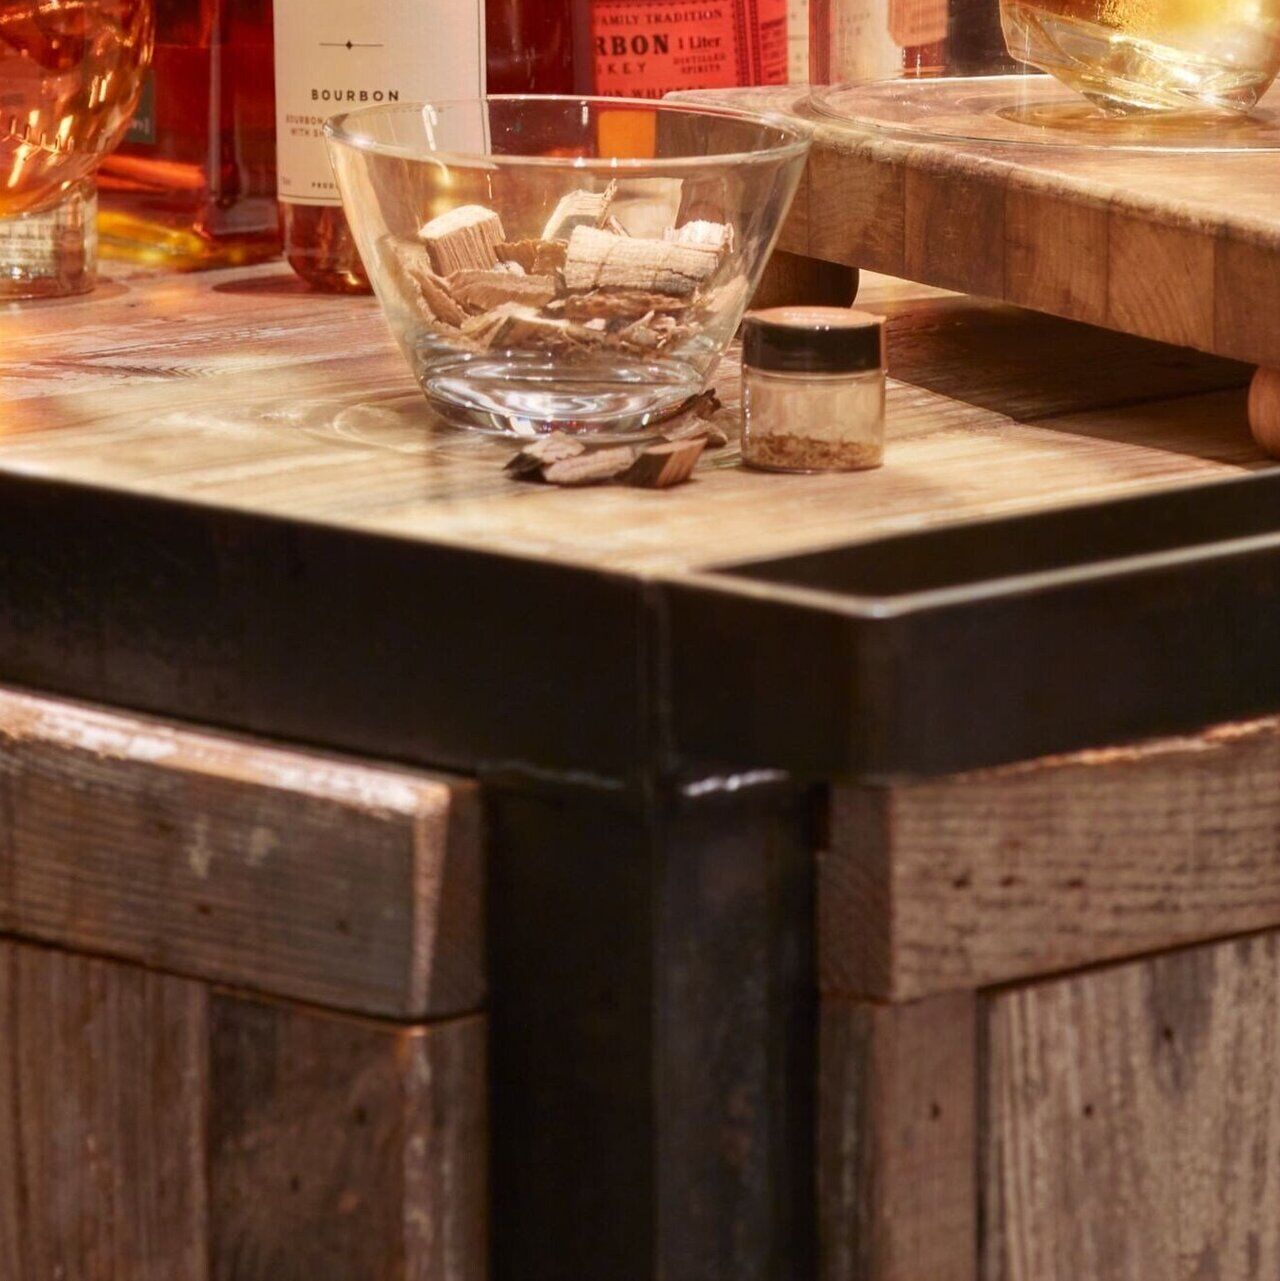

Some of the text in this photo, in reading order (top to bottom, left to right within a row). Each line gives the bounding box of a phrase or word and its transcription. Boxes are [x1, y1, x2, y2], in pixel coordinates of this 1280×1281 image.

[596, 9, 723, 27] AMILY TRADITION
[596, 33, 669, 57] RBON
[689, 36, 721, 50] Liter
[311, 88, 400, 102] BOURBON
